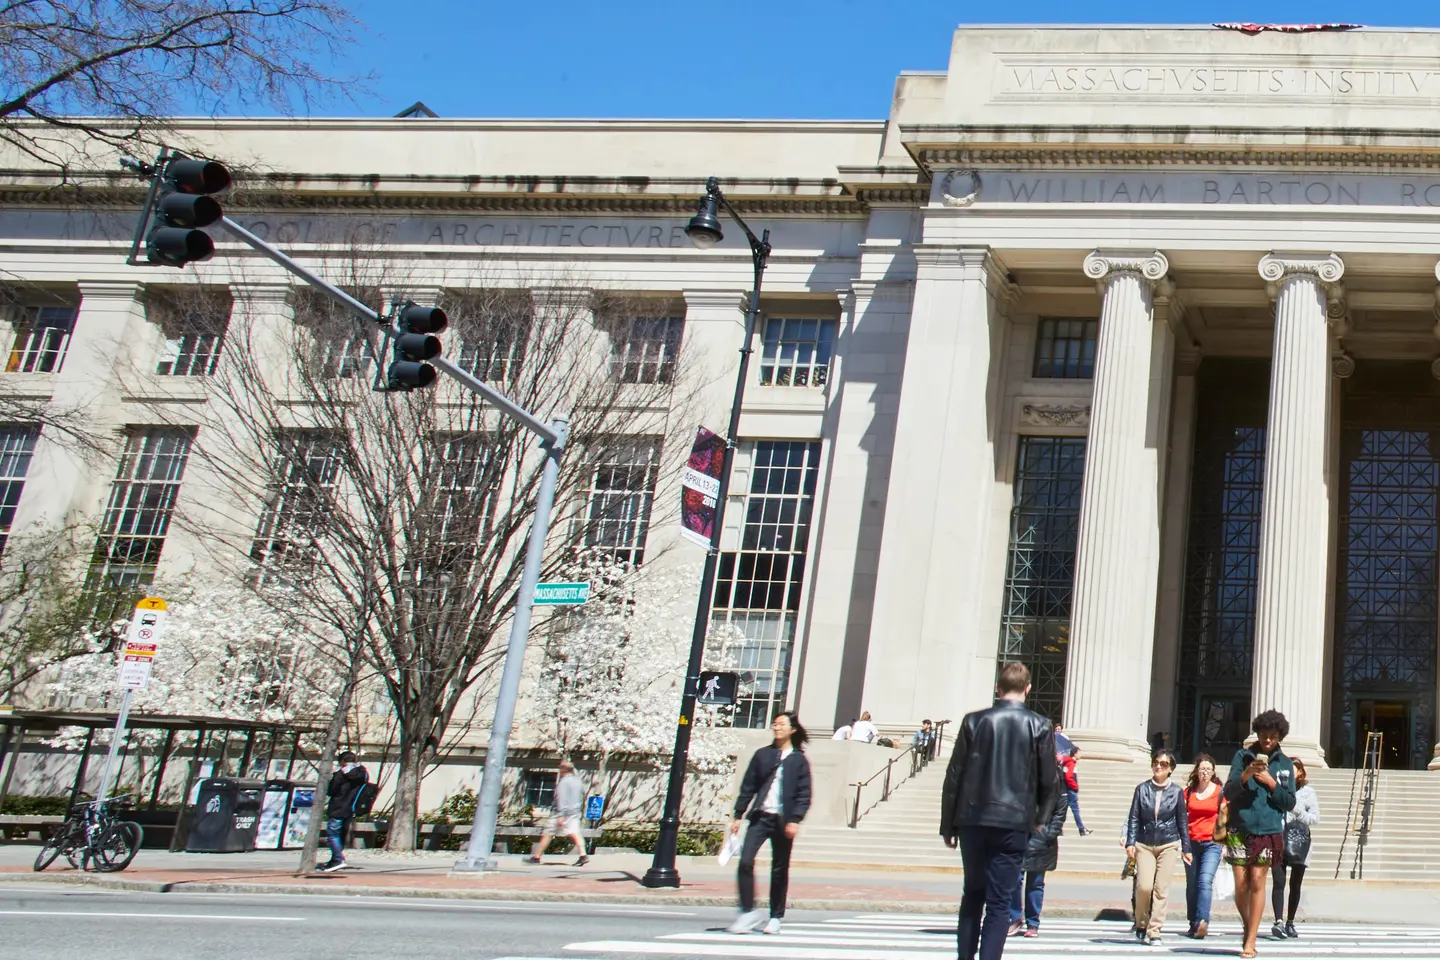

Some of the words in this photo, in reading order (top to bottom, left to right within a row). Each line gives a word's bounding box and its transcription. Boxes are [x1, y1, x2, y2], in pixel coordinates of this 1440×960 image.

[1013, 67, 1284, 93] MASSACHVSETTS
[1006, 178, 1167, 204] WILLIAM
[1202, 179, 1363, 206] BARTON
[425, 223, 687, 248] ARCHITECTVRE
[684, 472, 702, 487] APRIL
